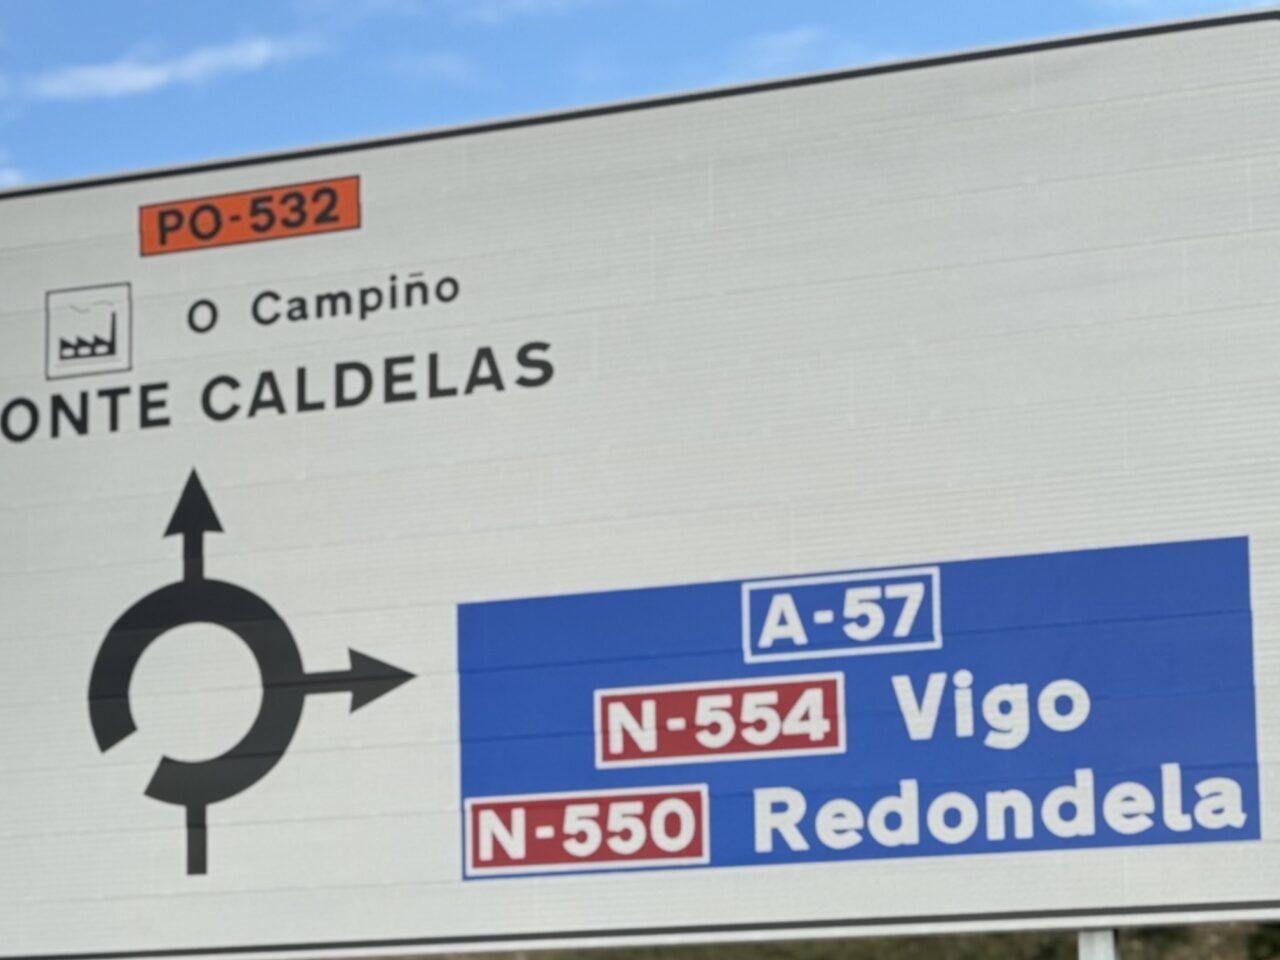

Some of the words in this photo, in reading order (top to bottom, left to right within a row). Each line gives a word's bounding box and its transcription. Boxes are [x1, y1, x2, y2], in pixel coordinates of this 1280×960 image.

[157, 185, 341, 247] PO-532
[187, 299, 219, 334] O
[251, 271, 461, 326] Campiño
[200, 341, 556, 422] CALDELAS
[757, 582, 926, 649] A-57
[606, 686, 832, 755] N-554
[892, 669, 1092, 750] Vigo
[477, 797, 697, 862] N-550
[753, 763, 1248, 854] Redondela
